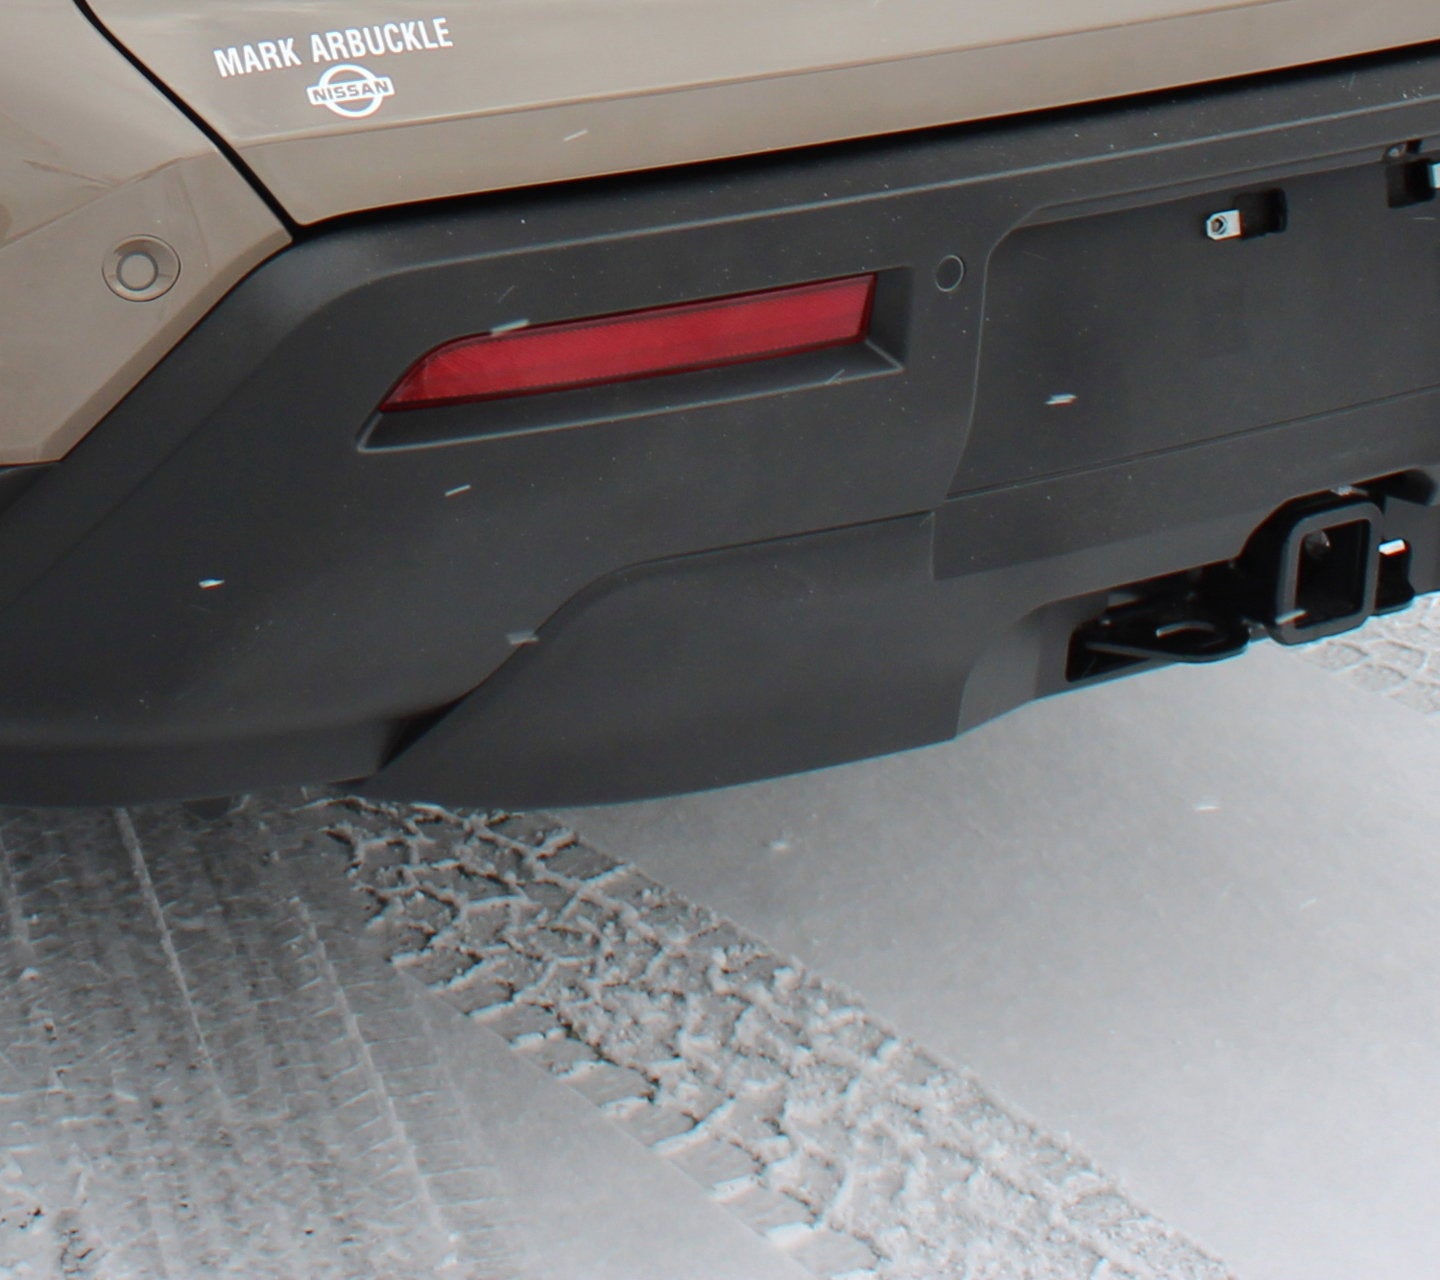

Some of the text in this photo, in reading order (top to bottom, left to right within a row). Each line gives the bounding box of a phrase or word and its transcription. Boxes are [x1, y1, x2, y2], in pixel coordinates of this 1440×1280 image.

[213, 16, 454, 79] MARK ARBUCKLE
[311, 80, 390, 102] NISSAN
